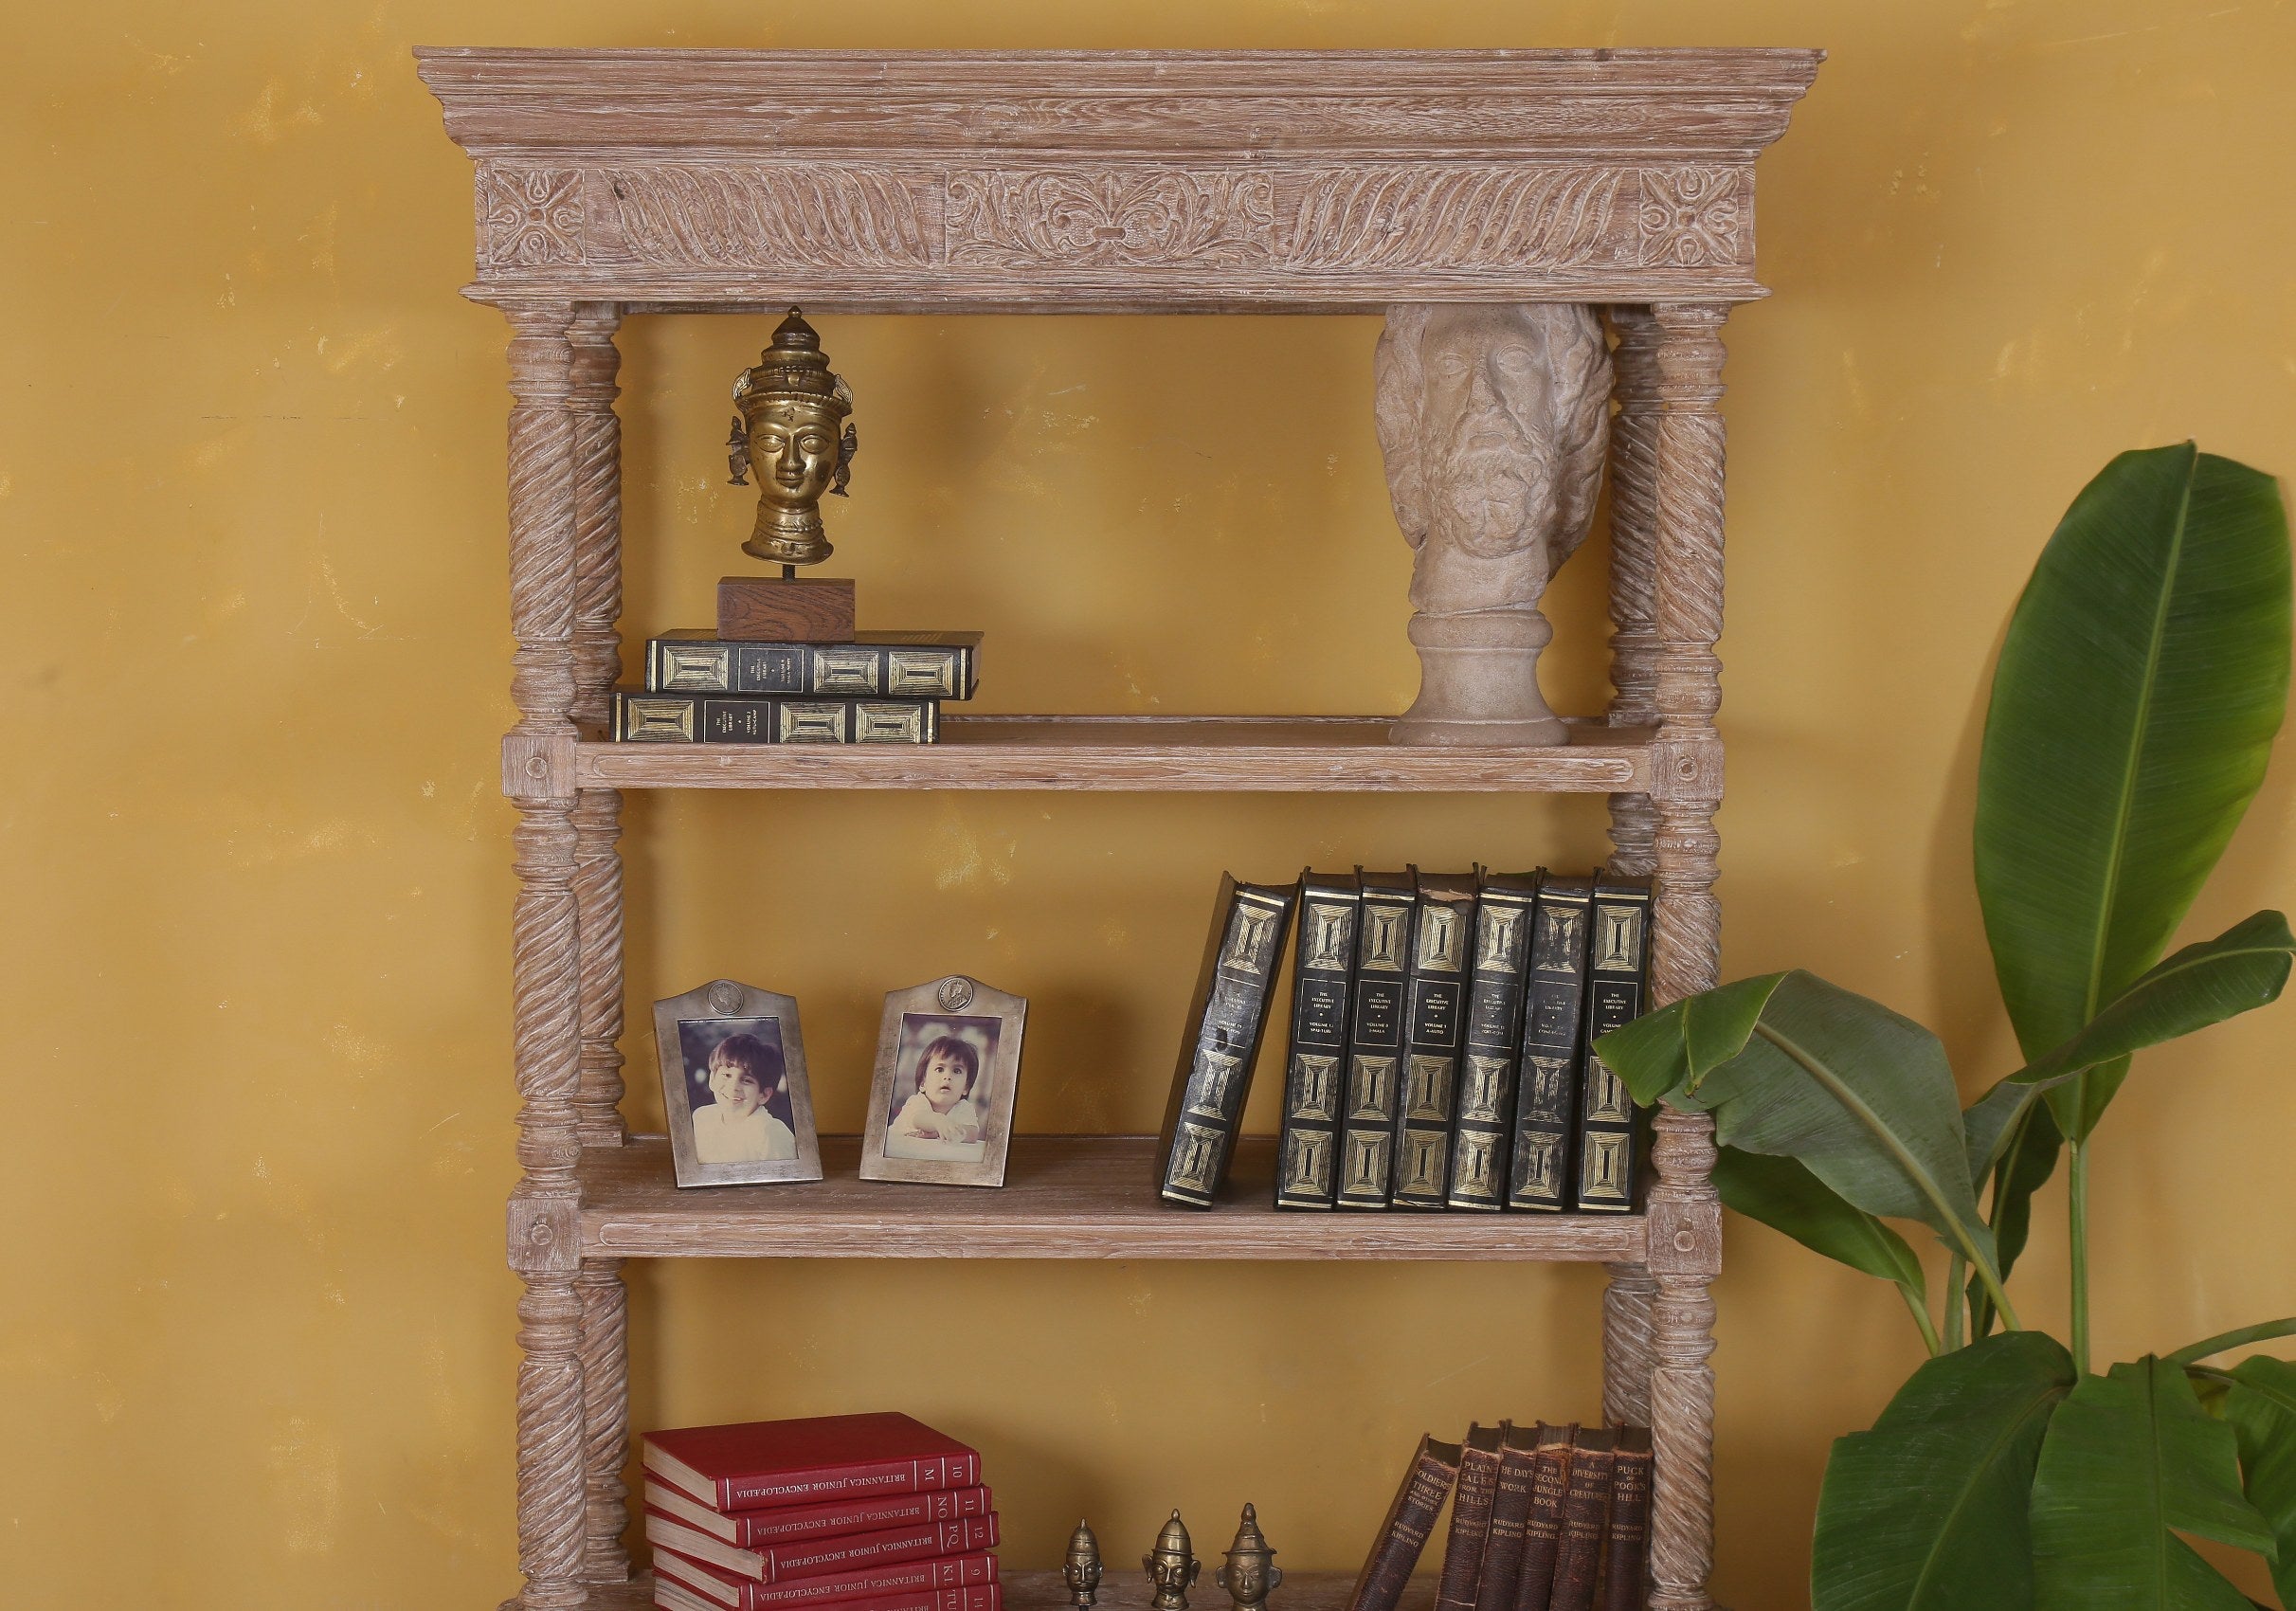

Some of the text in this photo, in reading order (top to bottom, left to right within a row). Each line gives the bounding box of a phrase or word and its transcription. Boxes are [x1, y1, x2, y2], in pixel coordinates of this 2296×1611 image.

[952, 1466, 963, 1478] 10
[1464, 1461, 1492, 1474] PLAIN
[1501, 1466, 1512, 1475] HE
[1543, 1466, 1557, 1475] THE
[1618, 1465, 1644, 1475] PUCK
[924, 1468, 935, 1481] M
[736, 1474, 906, 1498] BRITANNICA JUNIOR ENCYCLOPÆDIA
[1414, 1480, 1441, 1500] THREE
[1461, 1484, 1477, 1493] ROM
[1500, 1482, 1527, 1493] WORK
[1533, 1485, 1564, 1495] JUNGLE
[1614, 1480, 1646, 1491] POOK'S
[1459, 1493, 1489, 1505] HILLS
[1534, 1496, 1557, 1508] BOOK
[1618, 1493, 1641, 1502] HILL
[937, 1496, 948, 1518] NO
[965, 1499, 974, 1511] 11
[1407, 1496, 1433, 1511] STORIES
[757, 1507, 920, 1535] BRITANNICA JUNIOR ENCYCLOPÆDIA
[1455, 1517, 1487, 1528] RUDYARD
[1493, 1518, 1525, 1529] RUDYARD
[1527, 1519, 1559, 1530] RUDYARD
[1568, 1520, 1600, 1530] RUDYARD
[974, 1527, 984, 1539] 12
[1394, 1521, 1423, 1539] RUDYARD
[1455, 1528, 1483, 1537] KIPLING
[1612, 1523, 1642, 1532] RUDYARD
[947, 1525, 959, 1548] PQ
[1391, 1530, 1419, 1548] KIPLING
[1492, 1529, 1522, 1538] KIPLING
[1526, 1529, 1555, 1539] KIPLING
[1568, 1530, 1598, 1540] KIPLING
[1612, 1532, 1640, 1542] KIPLING
[780, 1536, 932, 1569] BRITANNICA JUNIOR ENCYCLOPÆDIA
[760, 1574, 925, 1602] BRITANNICA JUNIOR ENCYCLOPÆDIA
[947, 1589, 957, 1610] TU
